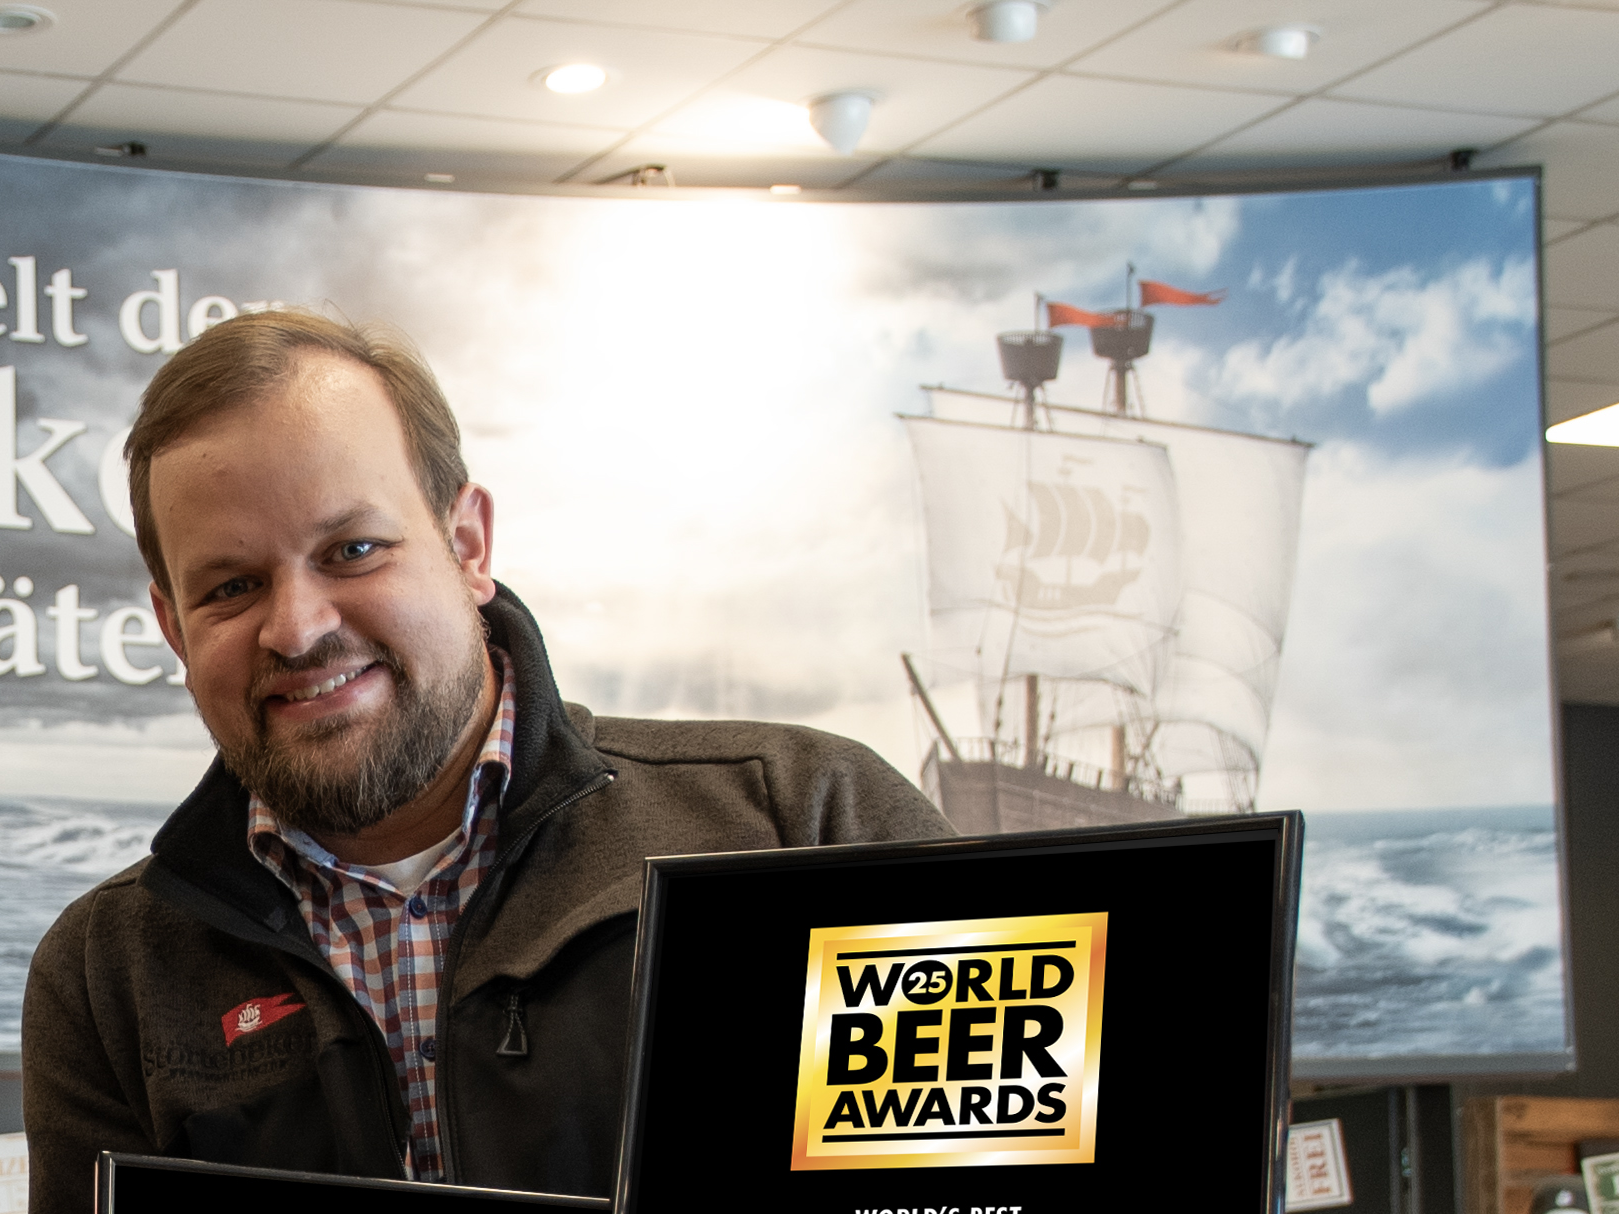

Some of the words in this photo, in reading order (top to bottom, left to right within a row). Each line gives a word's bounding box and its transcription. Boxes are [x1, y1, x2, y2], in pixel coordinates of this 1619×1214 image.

[118, 268, 284, 354] de
[826, 1004, 1069, 1086] BEER
[823, 1082, 1067, 1129] AWARDS
[1303, 1132, 1333, 1195] FREI
